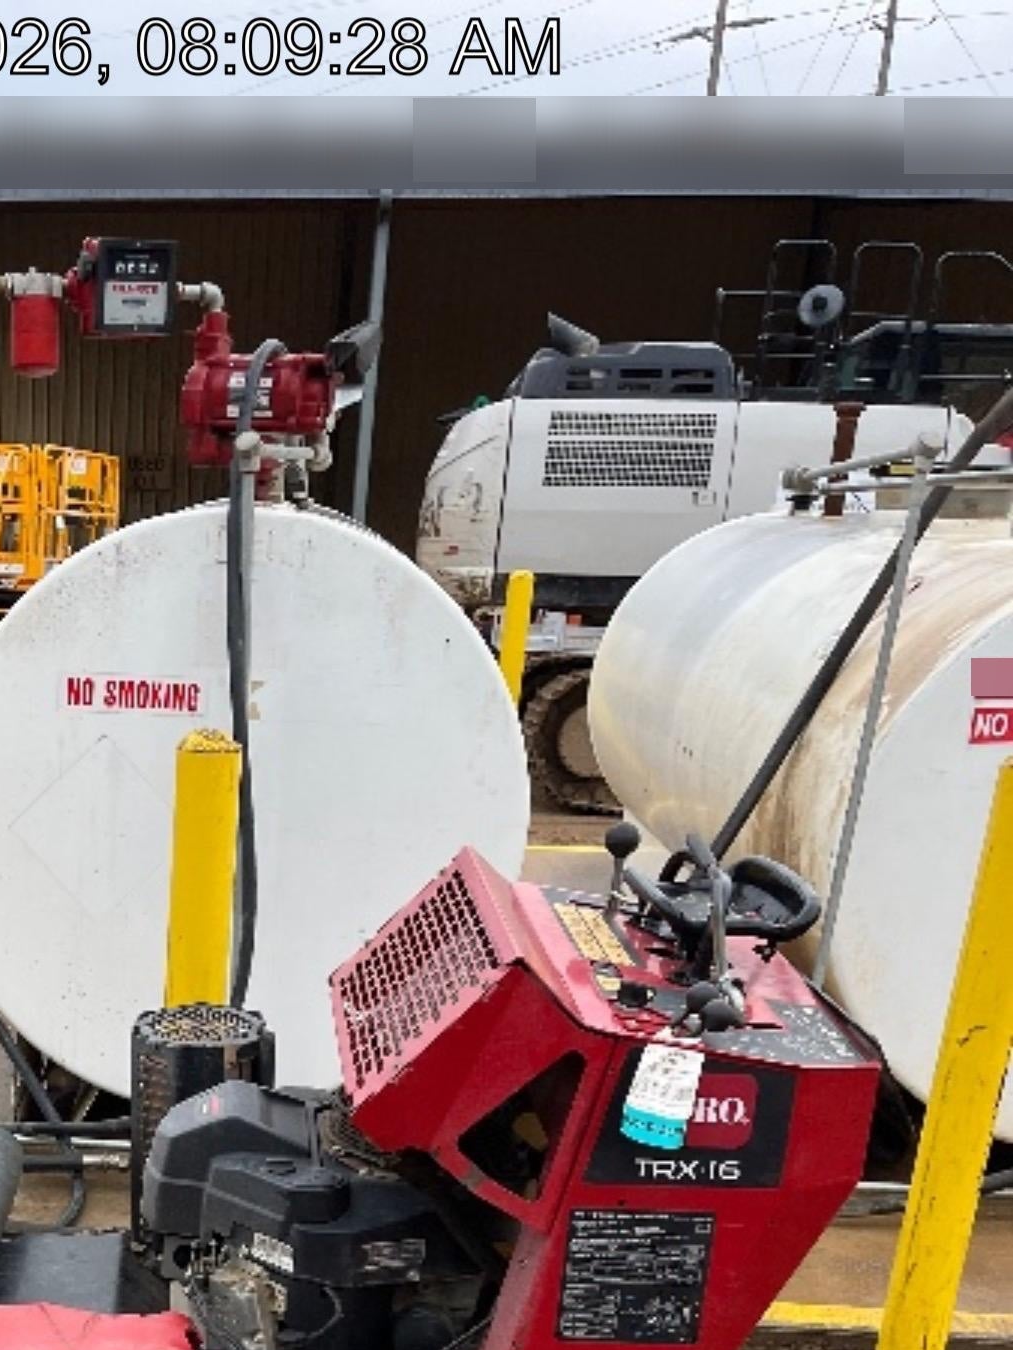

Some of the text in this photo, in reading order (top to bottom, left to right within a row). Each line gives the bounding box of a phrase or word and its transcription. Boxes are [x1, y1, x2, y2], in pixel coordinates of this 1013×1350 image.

[67, 677, 201, 712] NO SMOKING
[973, 712, 1009, 738] NO
